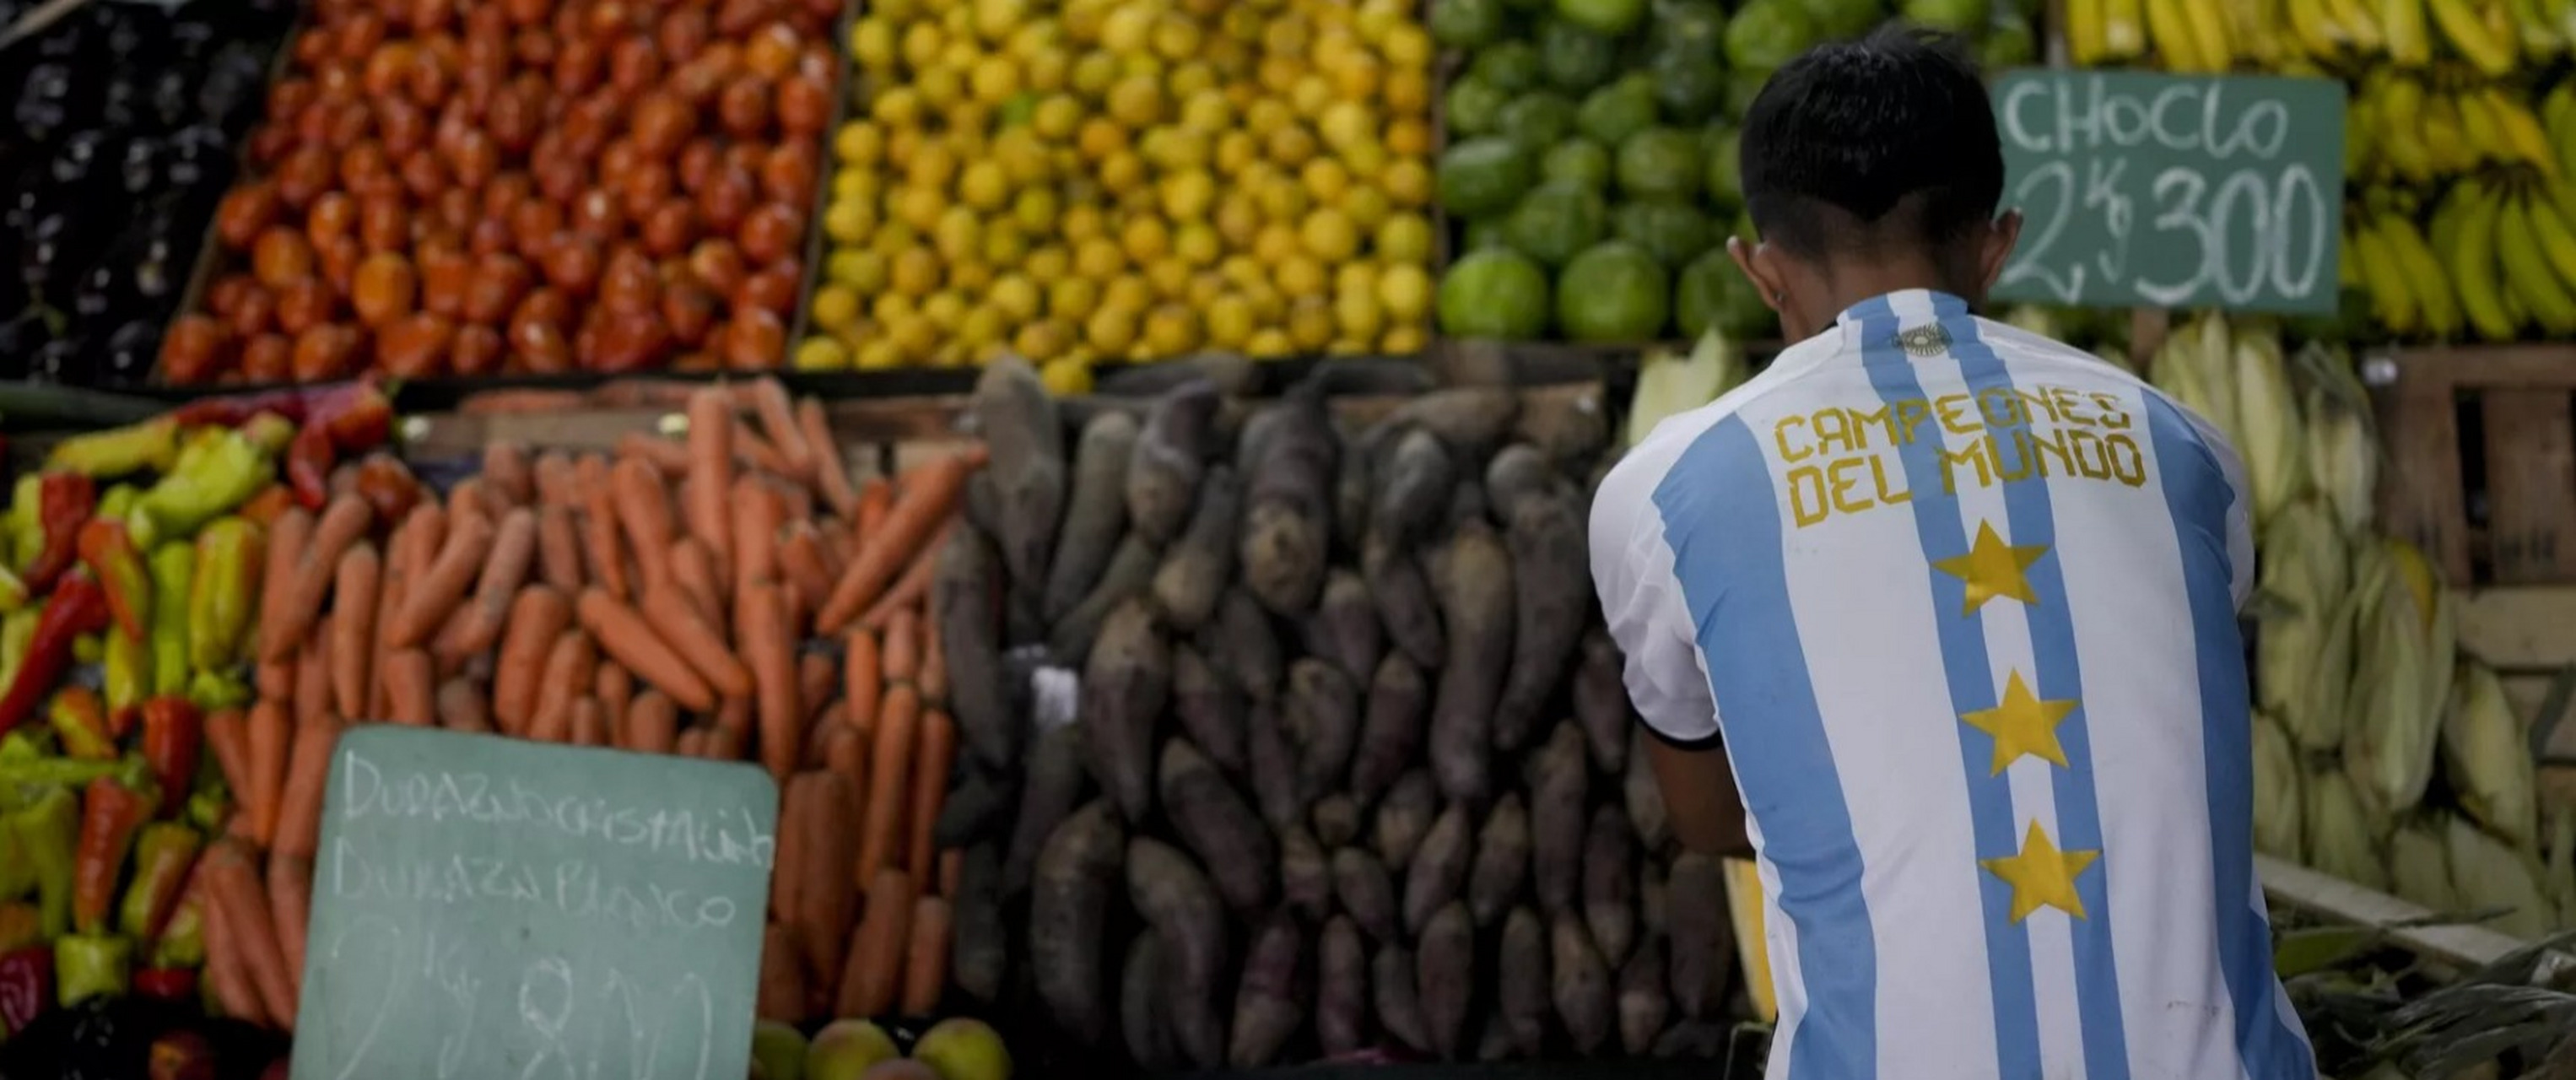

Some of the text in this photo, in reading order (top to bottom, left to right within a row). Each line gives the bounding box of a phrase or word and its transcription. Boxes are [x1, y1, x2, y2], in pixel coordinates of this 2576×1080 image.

[2134, 162, 2327, 305] 300
[1774, 383, 2131, 463] CAMPEONES
[1785, 428, 2147, 529] DEL MUNDO
